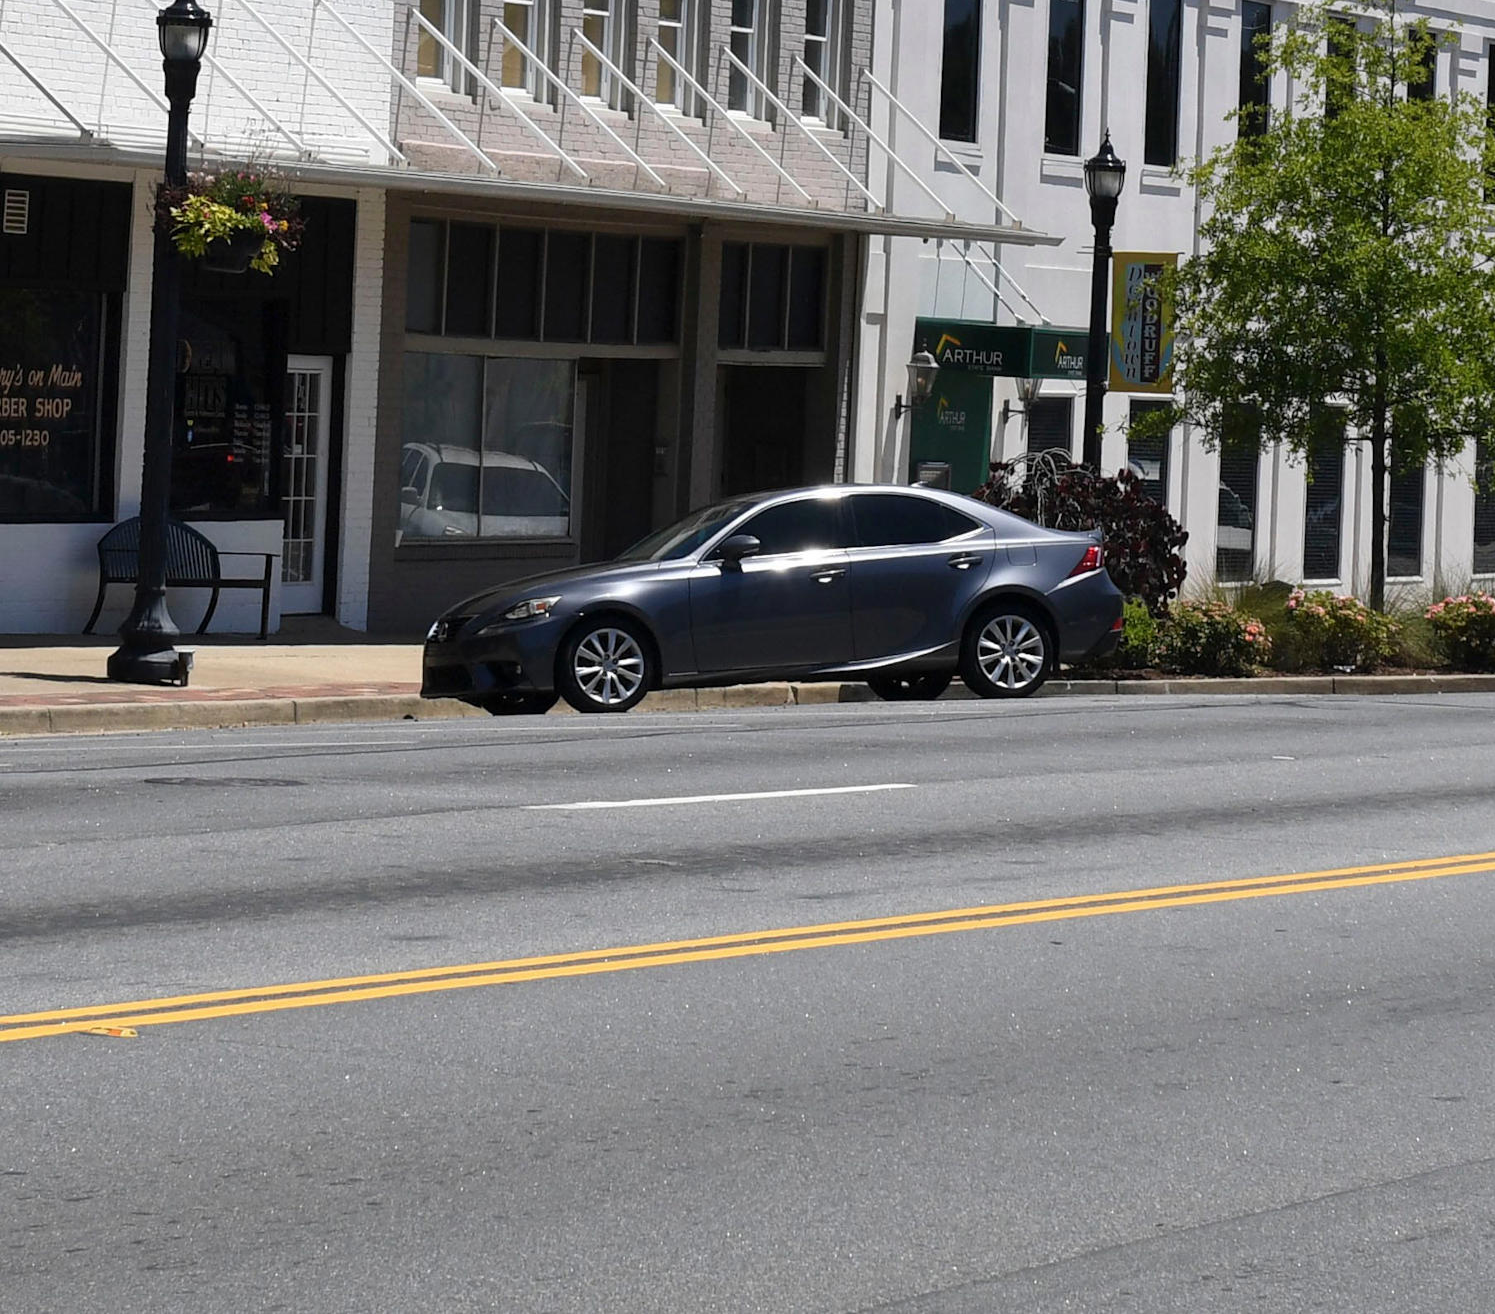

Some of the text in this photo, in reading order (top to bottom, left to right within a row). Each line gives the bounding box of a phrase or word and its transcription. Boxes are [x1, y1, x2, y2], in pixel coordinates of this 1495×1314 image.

[942, 348, 1003, 366] ARTHUR
[1057, 355, 1084, 370] ARTHUR
[27, 369, 45, 387] on
[47, 363, 83, 387] Main
[35, 397, 73, 419] SHOP
[941, 410, 966, 426] ARTHUR
